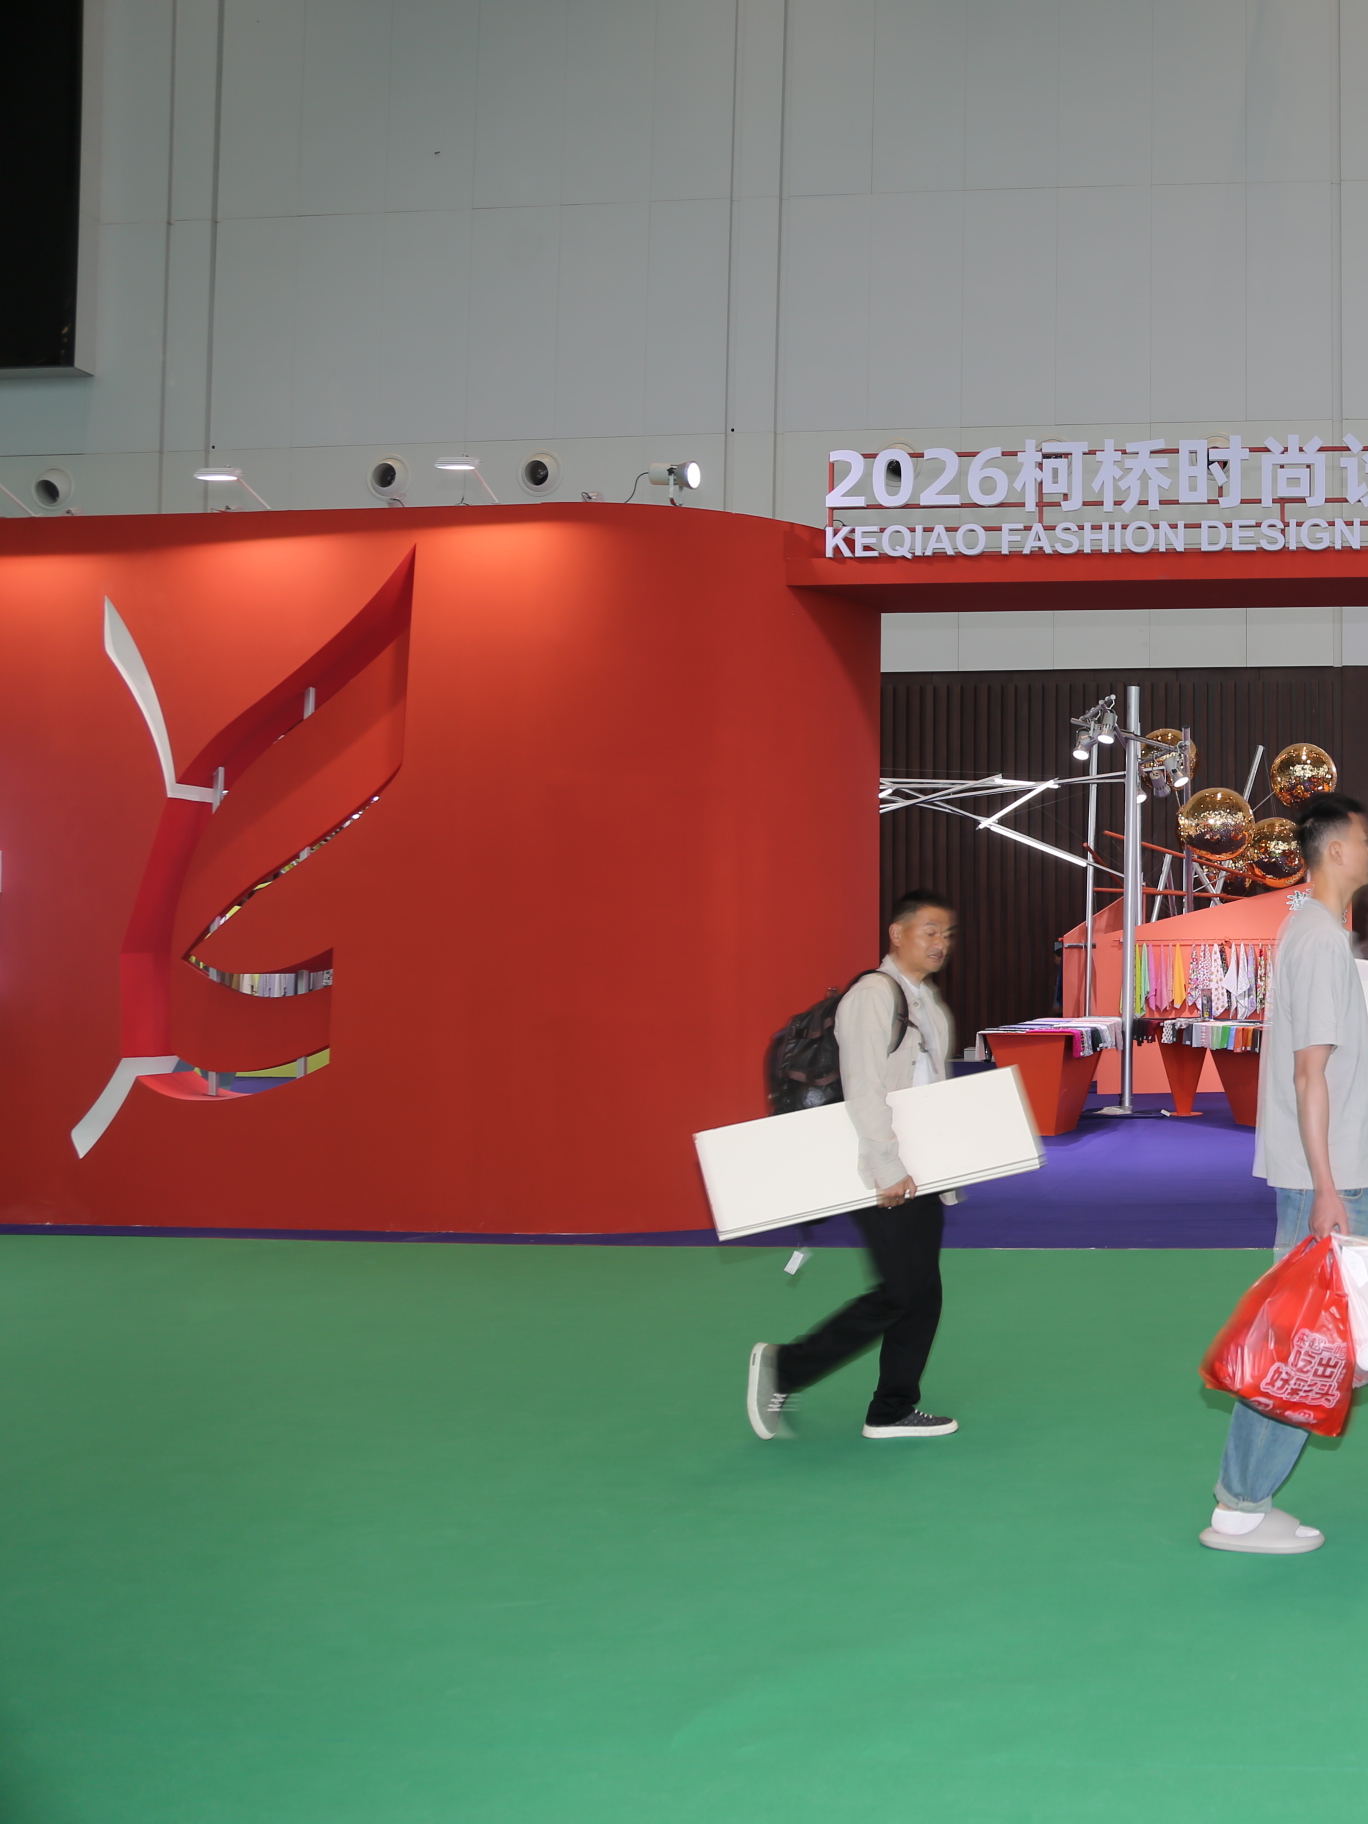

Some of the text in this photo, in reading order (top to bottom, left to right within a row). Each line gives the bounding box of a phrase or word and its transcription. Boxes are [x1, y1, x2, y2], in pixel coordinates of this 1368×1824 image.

[825, 524, 987, 559] KEQIAO
[1001, 520, 1186, 555] FASHION
[1200, 517, 1361, 552] DESIGN
[1290, 1348, 1341, 1380] 吃出
[1262, 1364, 1340, 1407] 好彩头
